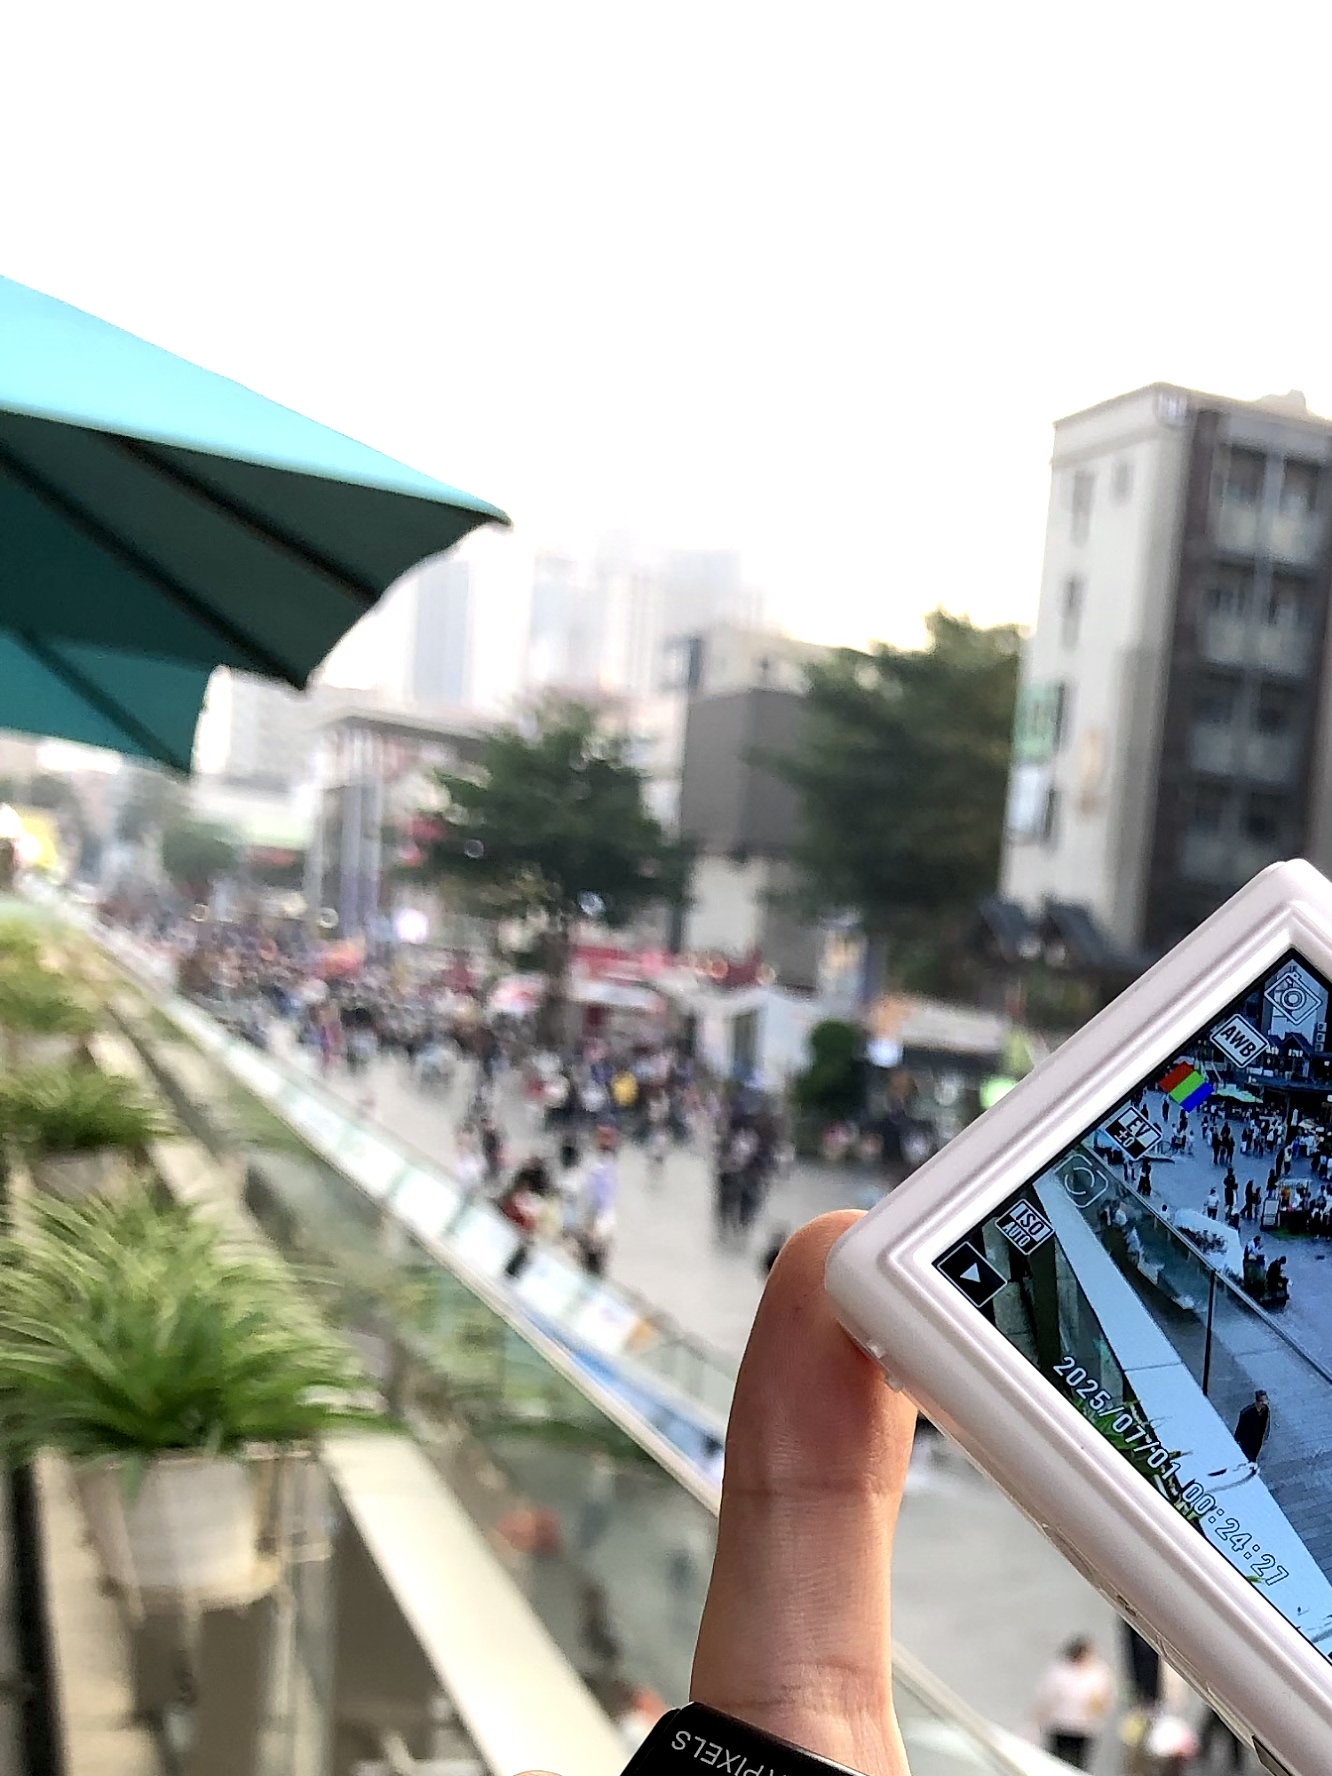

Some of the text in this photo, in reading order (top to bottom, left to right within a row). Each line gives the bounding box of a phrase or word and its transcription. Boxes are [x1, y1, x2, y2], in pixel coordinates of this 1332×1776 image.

[1221, 1024, 1257, 1058] AWB
[1126, 1115, 1150, 1139] EV
[1001, 1220, 1031, 1247] AUTO
[1014, 1207, 1043, 1235] ISO
[1053, 1356, 1290, 1587] 2025/07/01 00:24:27
